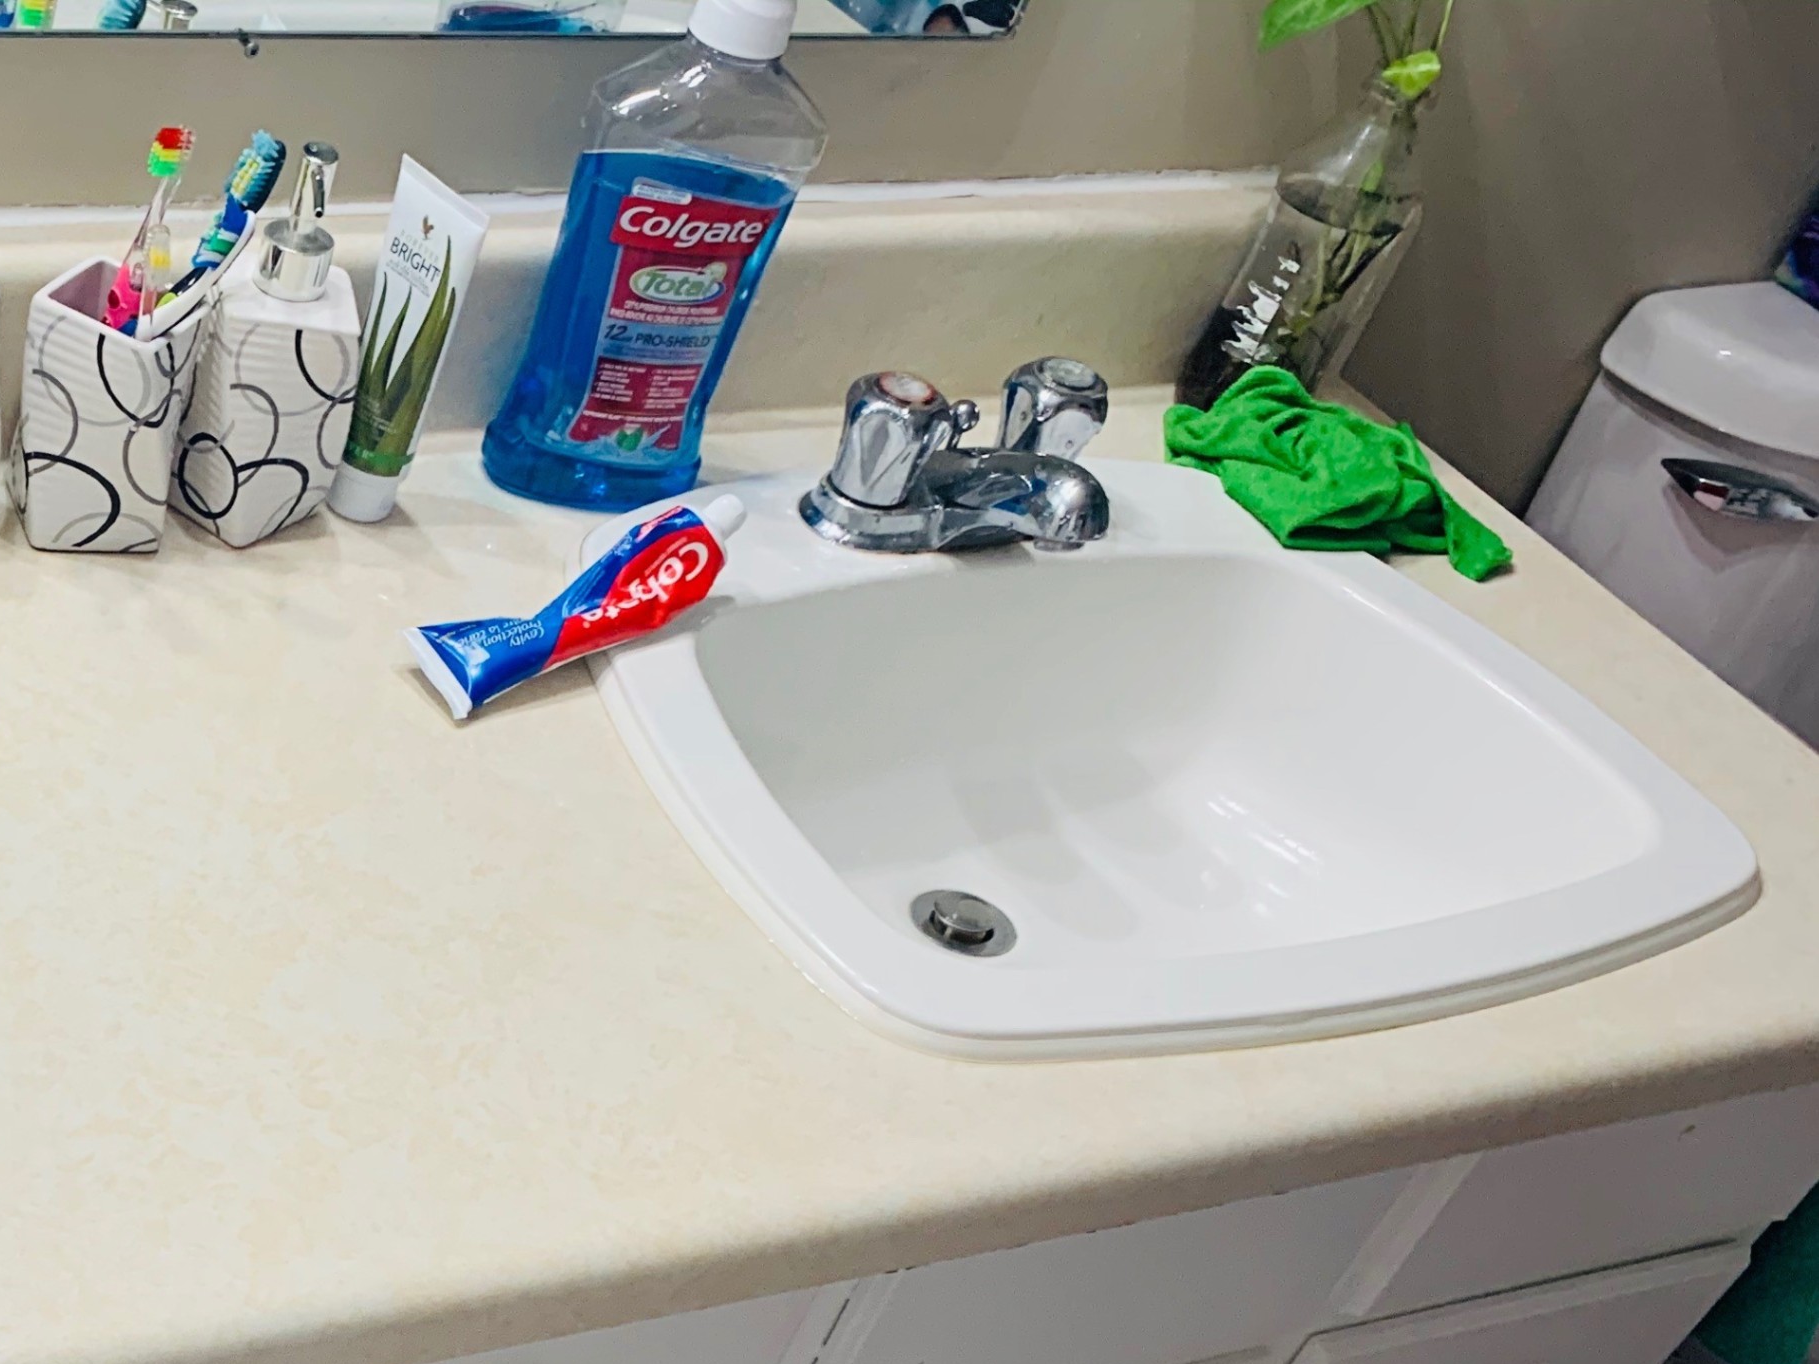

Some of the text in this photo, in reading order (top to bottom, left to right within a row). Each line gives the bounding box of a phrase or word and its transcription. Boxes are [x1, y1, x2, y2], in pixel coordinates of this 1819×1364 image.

[619, 206, 763, 248] Colgate
[390, 236, 441, 283] BRIGHT
[641, 270, 714, 297] Total
[509, 625, 546, 647] Cavity
